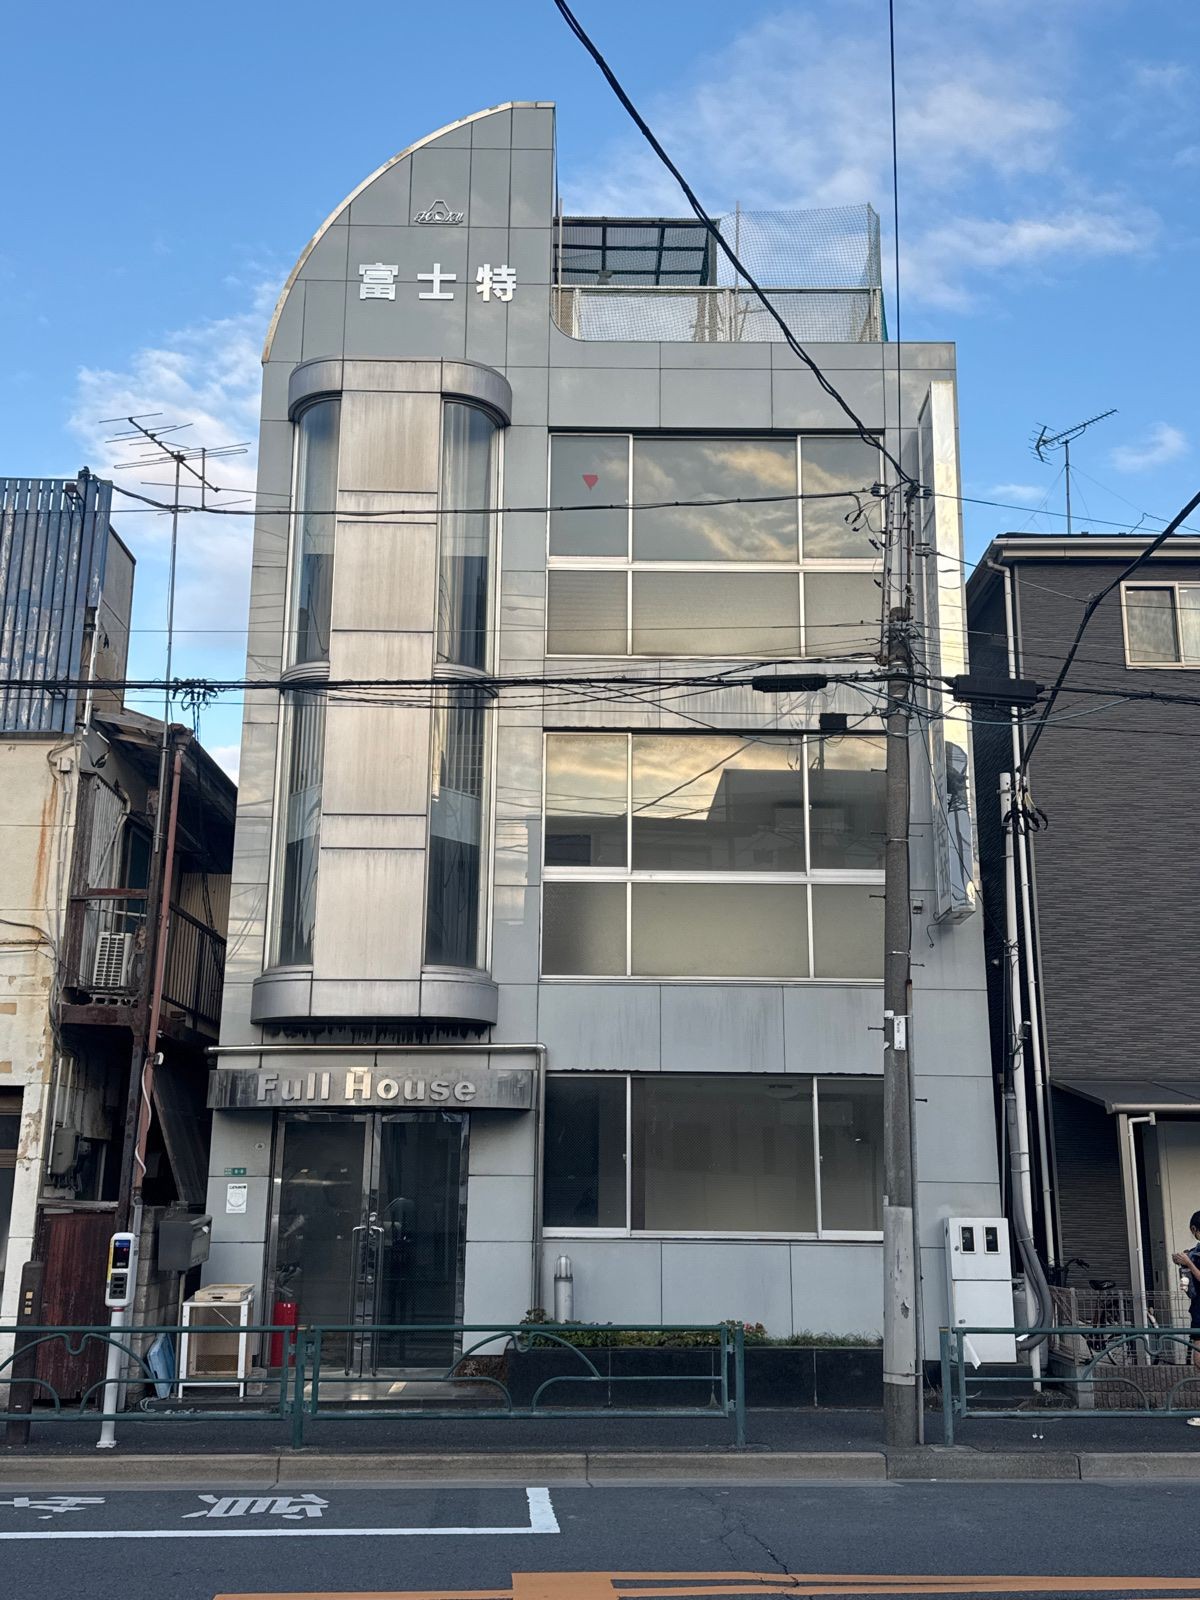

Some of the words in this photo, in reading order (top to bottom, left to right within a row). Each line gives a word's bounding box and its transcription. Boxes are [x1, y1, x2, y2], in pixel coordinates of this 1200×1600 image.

[358, 262, 517, 302] 富士特
[256, 1072, 330, 1101] Full
[344, 1072, 477, 1101] House
